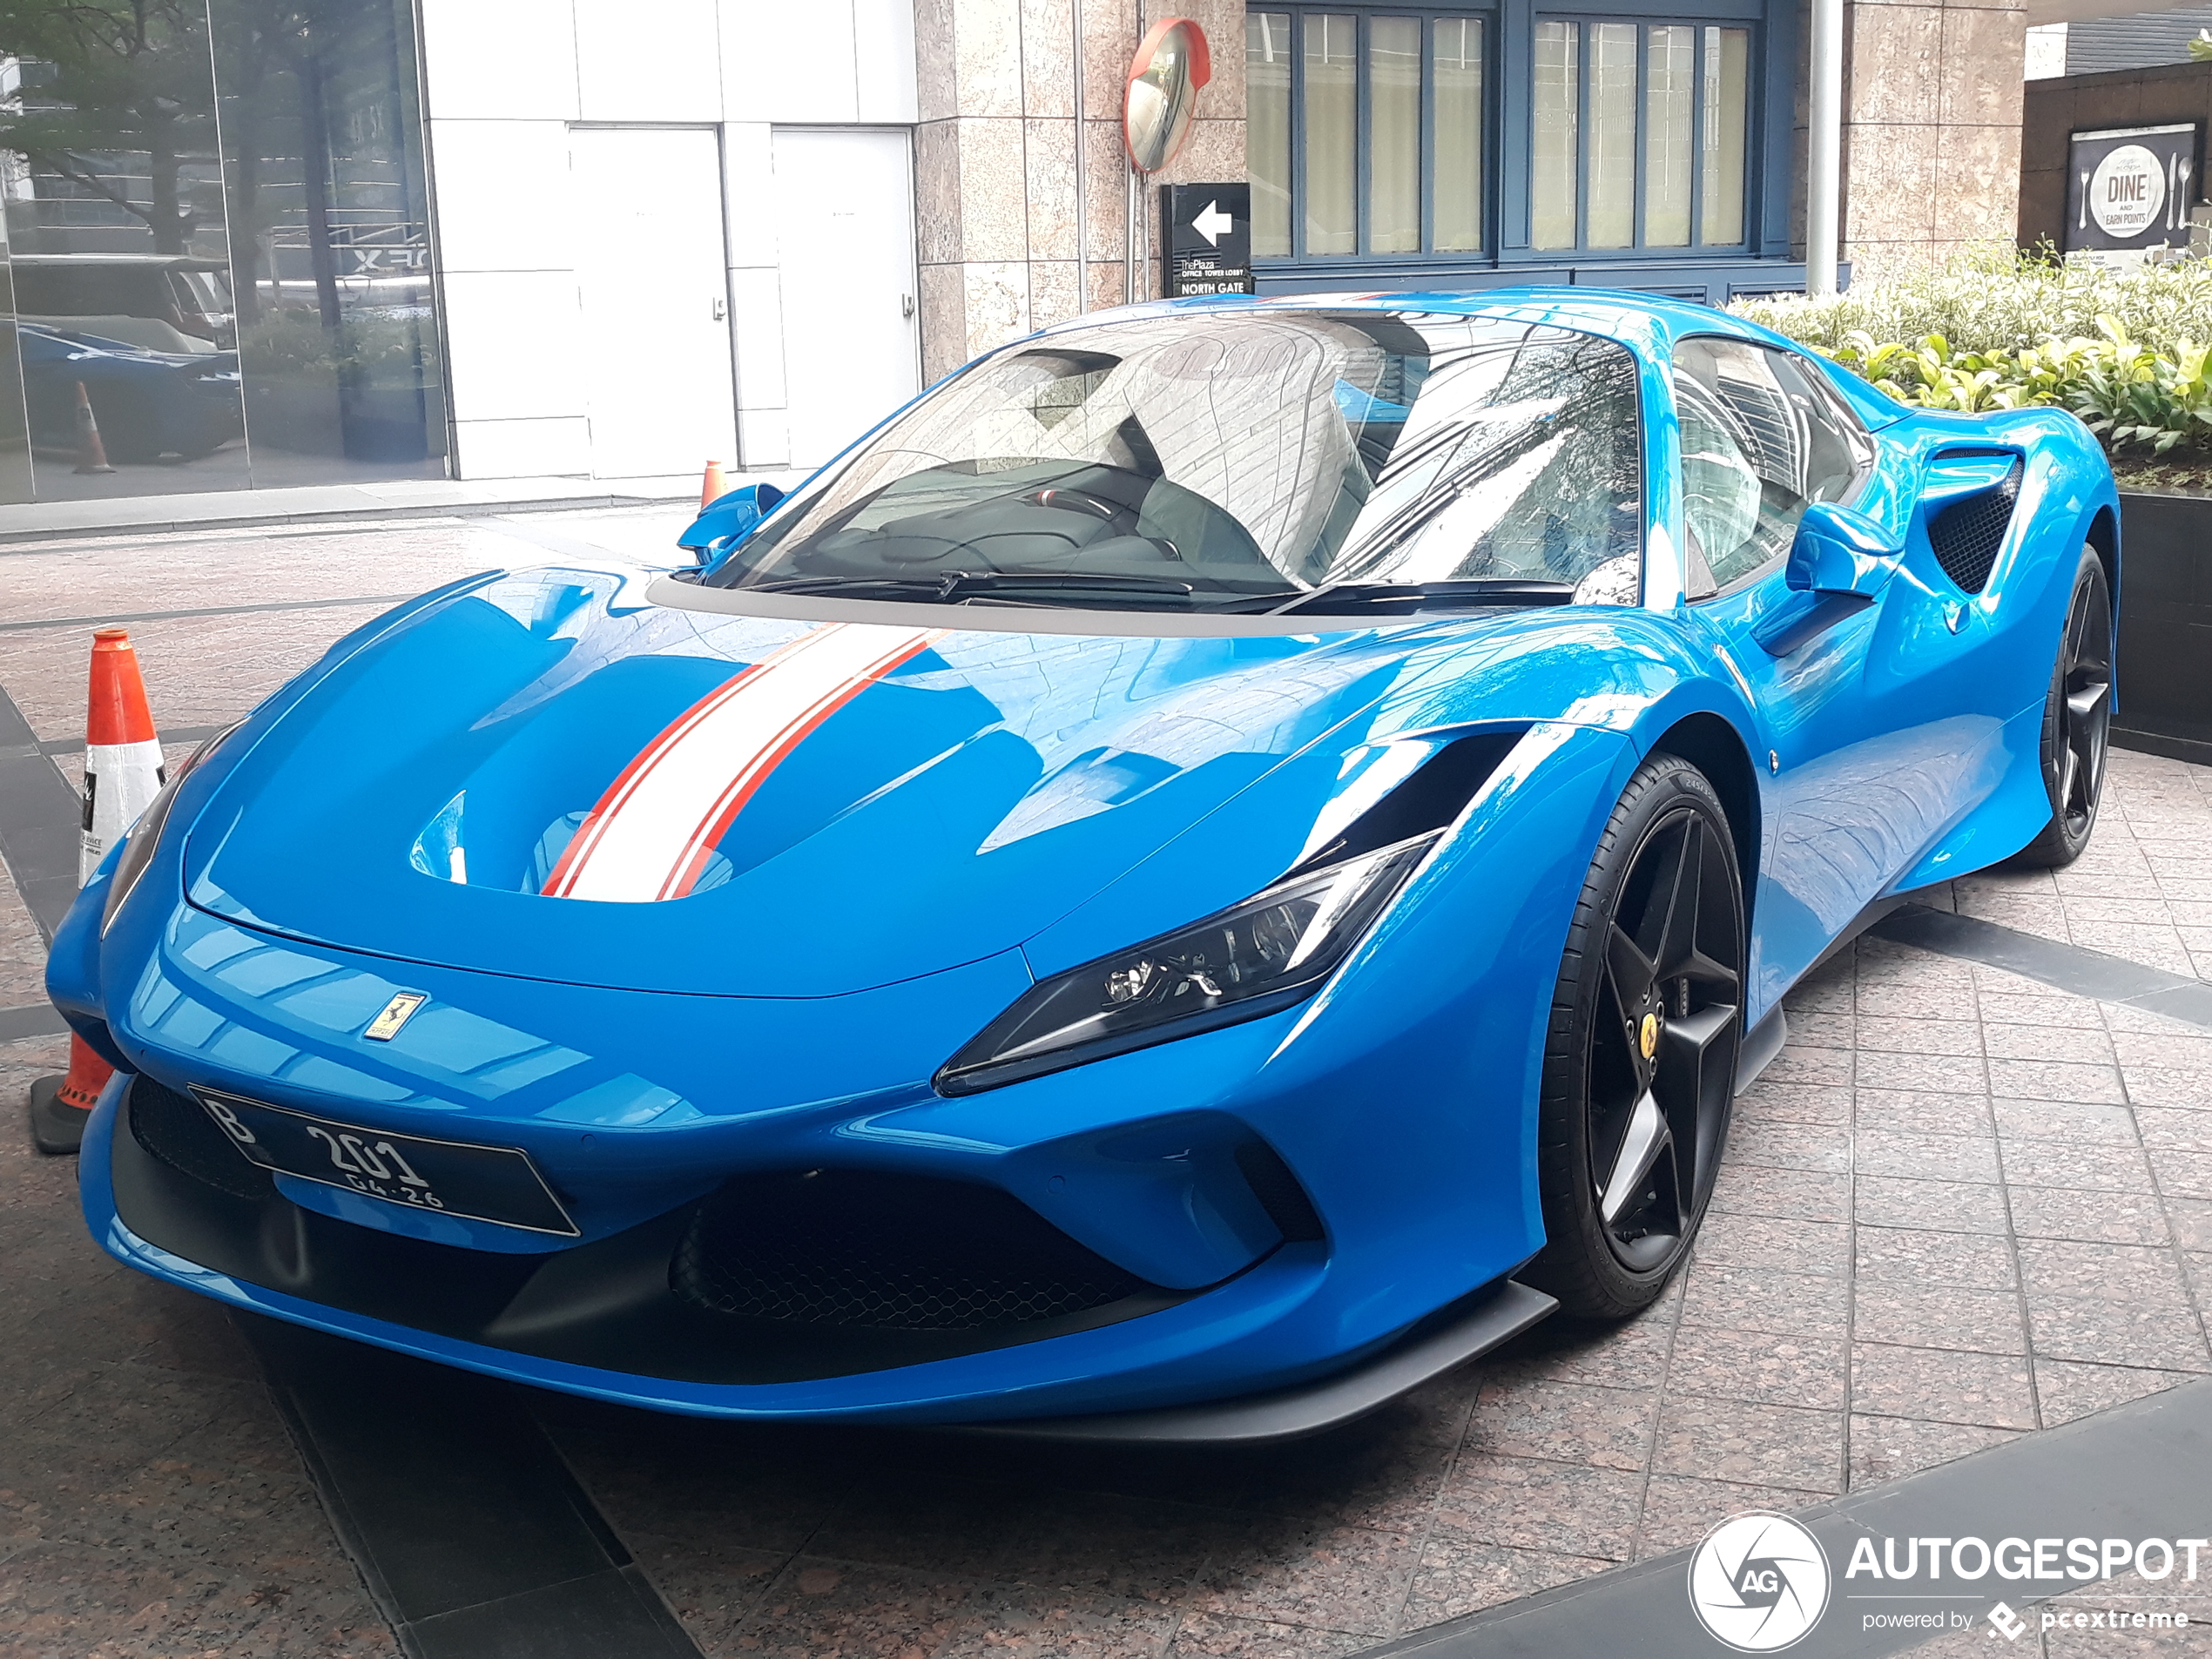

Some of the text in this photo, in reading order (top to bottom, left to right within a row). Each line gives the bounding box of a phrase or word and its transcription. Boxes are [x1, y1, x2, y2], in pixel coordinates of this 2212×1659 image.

[2108, 174, 2148, 203] DINE
[2106, 212, 2146, 226] EARN POINTS
[1182, 282, 1244, 294] NORTH GATE
[203, 1098, 429, 1188] B 201
